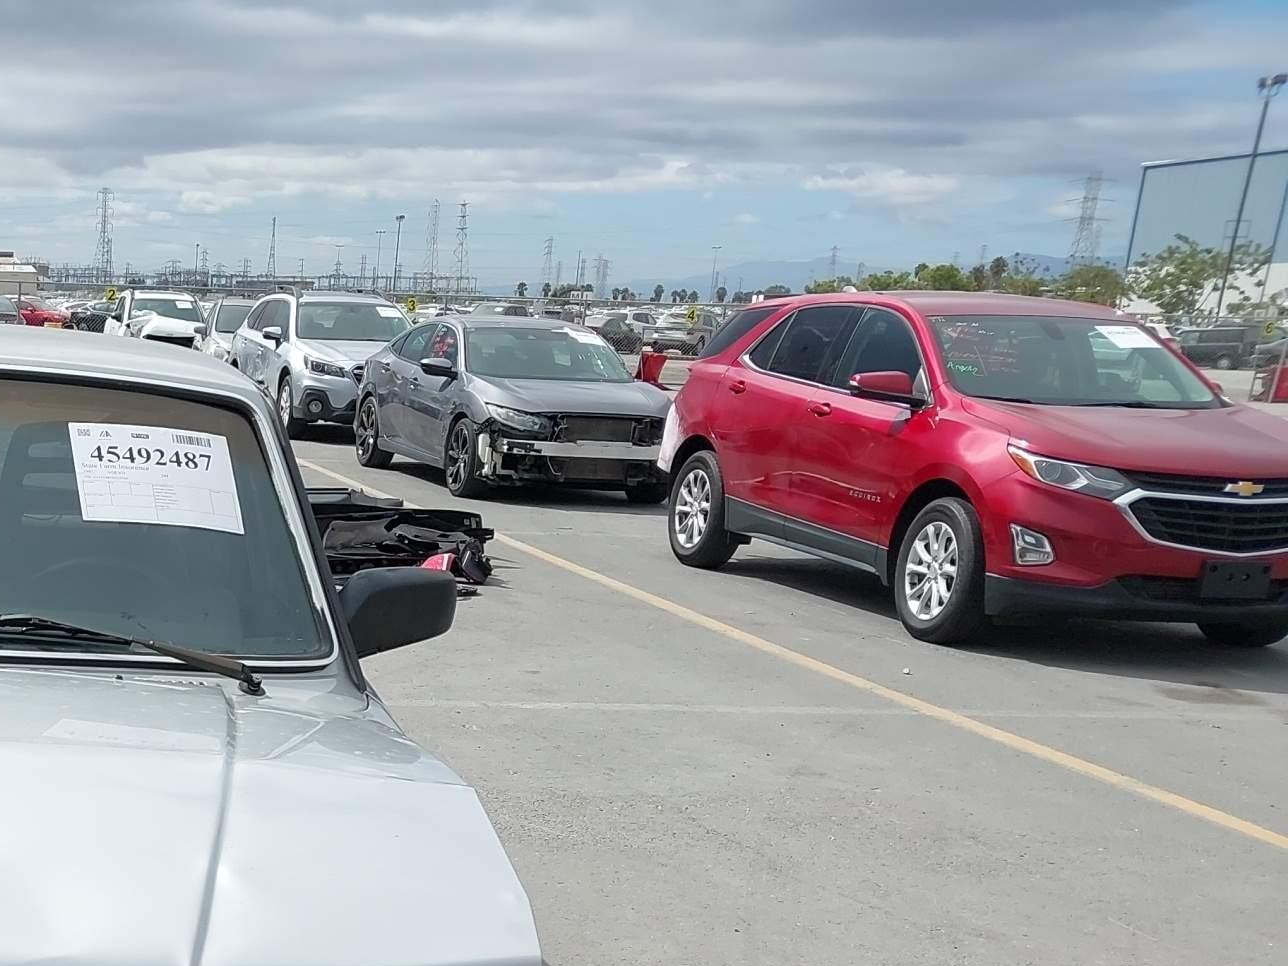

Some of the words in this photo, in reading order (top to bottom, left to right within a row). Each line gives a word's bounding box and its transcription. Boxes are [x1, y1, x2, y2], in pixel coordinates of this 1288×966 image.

[108, 289, 116, 301] 2
[408, 299, 416, 311] 3
[687, 309, 695, 321] 4
[90, 444, 212, 472] 45492487
